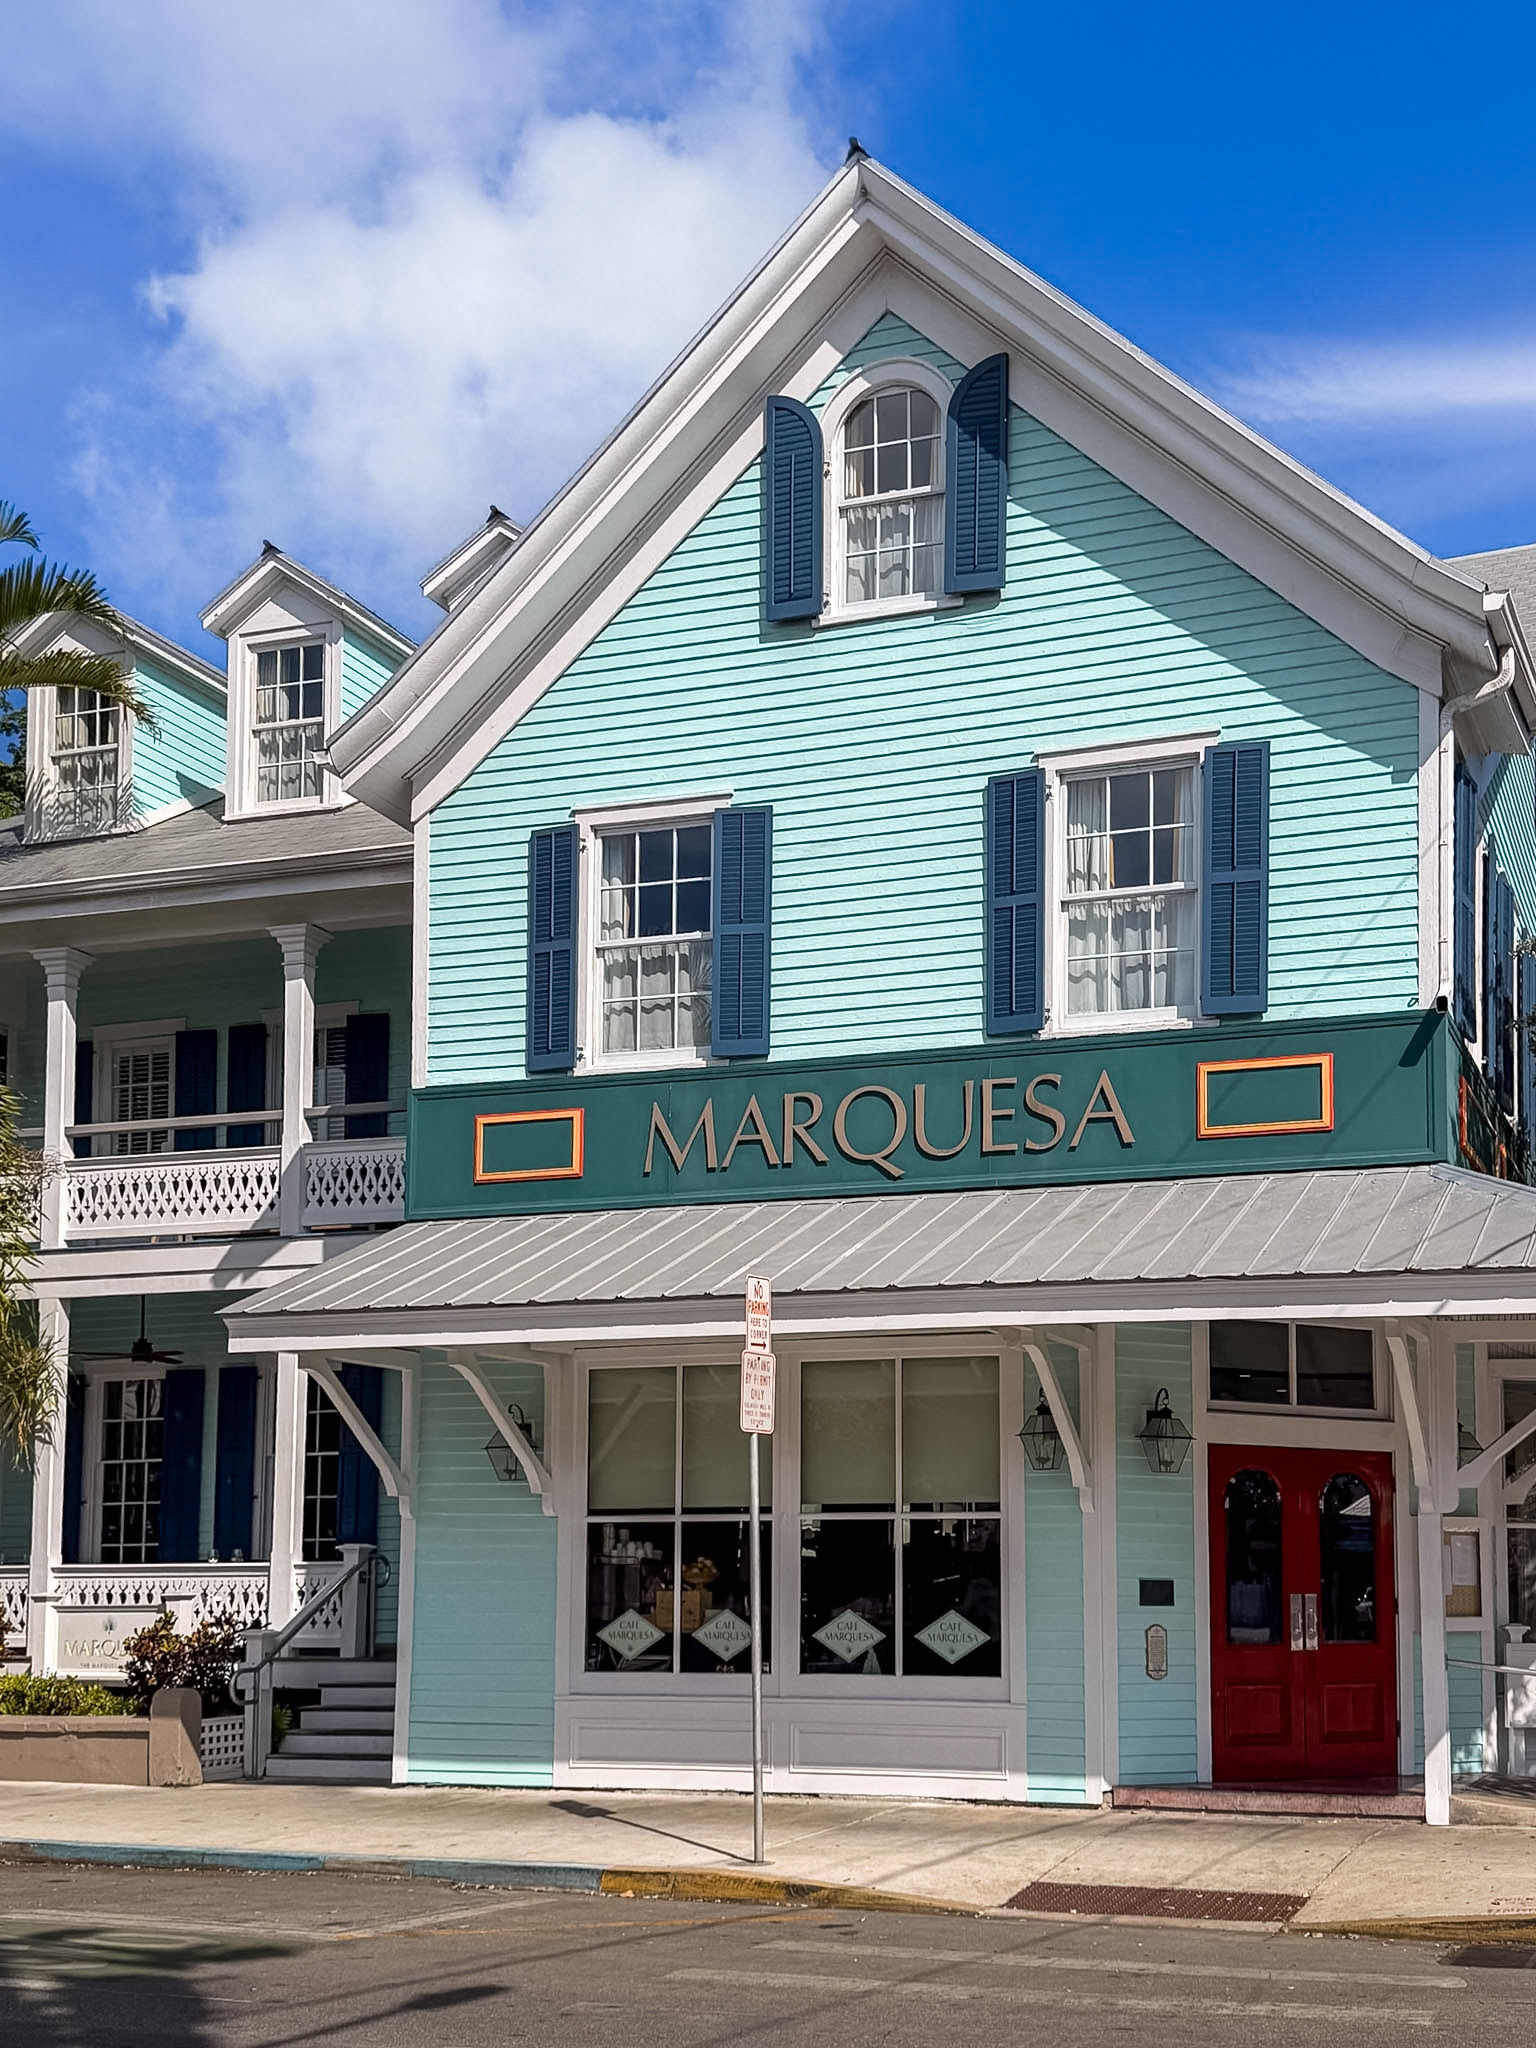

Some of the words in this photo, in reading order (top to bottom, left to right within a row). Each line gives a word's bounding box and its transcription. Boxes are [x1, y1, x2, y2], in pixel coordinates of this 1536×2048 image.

[643, 1069, 1136, 1179] MARQUESA
[753, 1284, 764, 1299] NO
[748, 1300, 769, 1316] PARKING
[762, 1318, 768, 1328] TO
[750, 1329, 768, 1340] CORNER
[746, 1357, 771, 1372] PARKING
[745, 1373, 752, 1385] BY
[750, 1388, 765, 1401] ONLY
[608, 1630, 655, 1641] MARQUESA
[825, 1631, 875, 1643] MARQUESA
[927, 1632, 979, 1643] MARQUESA
[64, 1639, 128, 1660] MARQU
